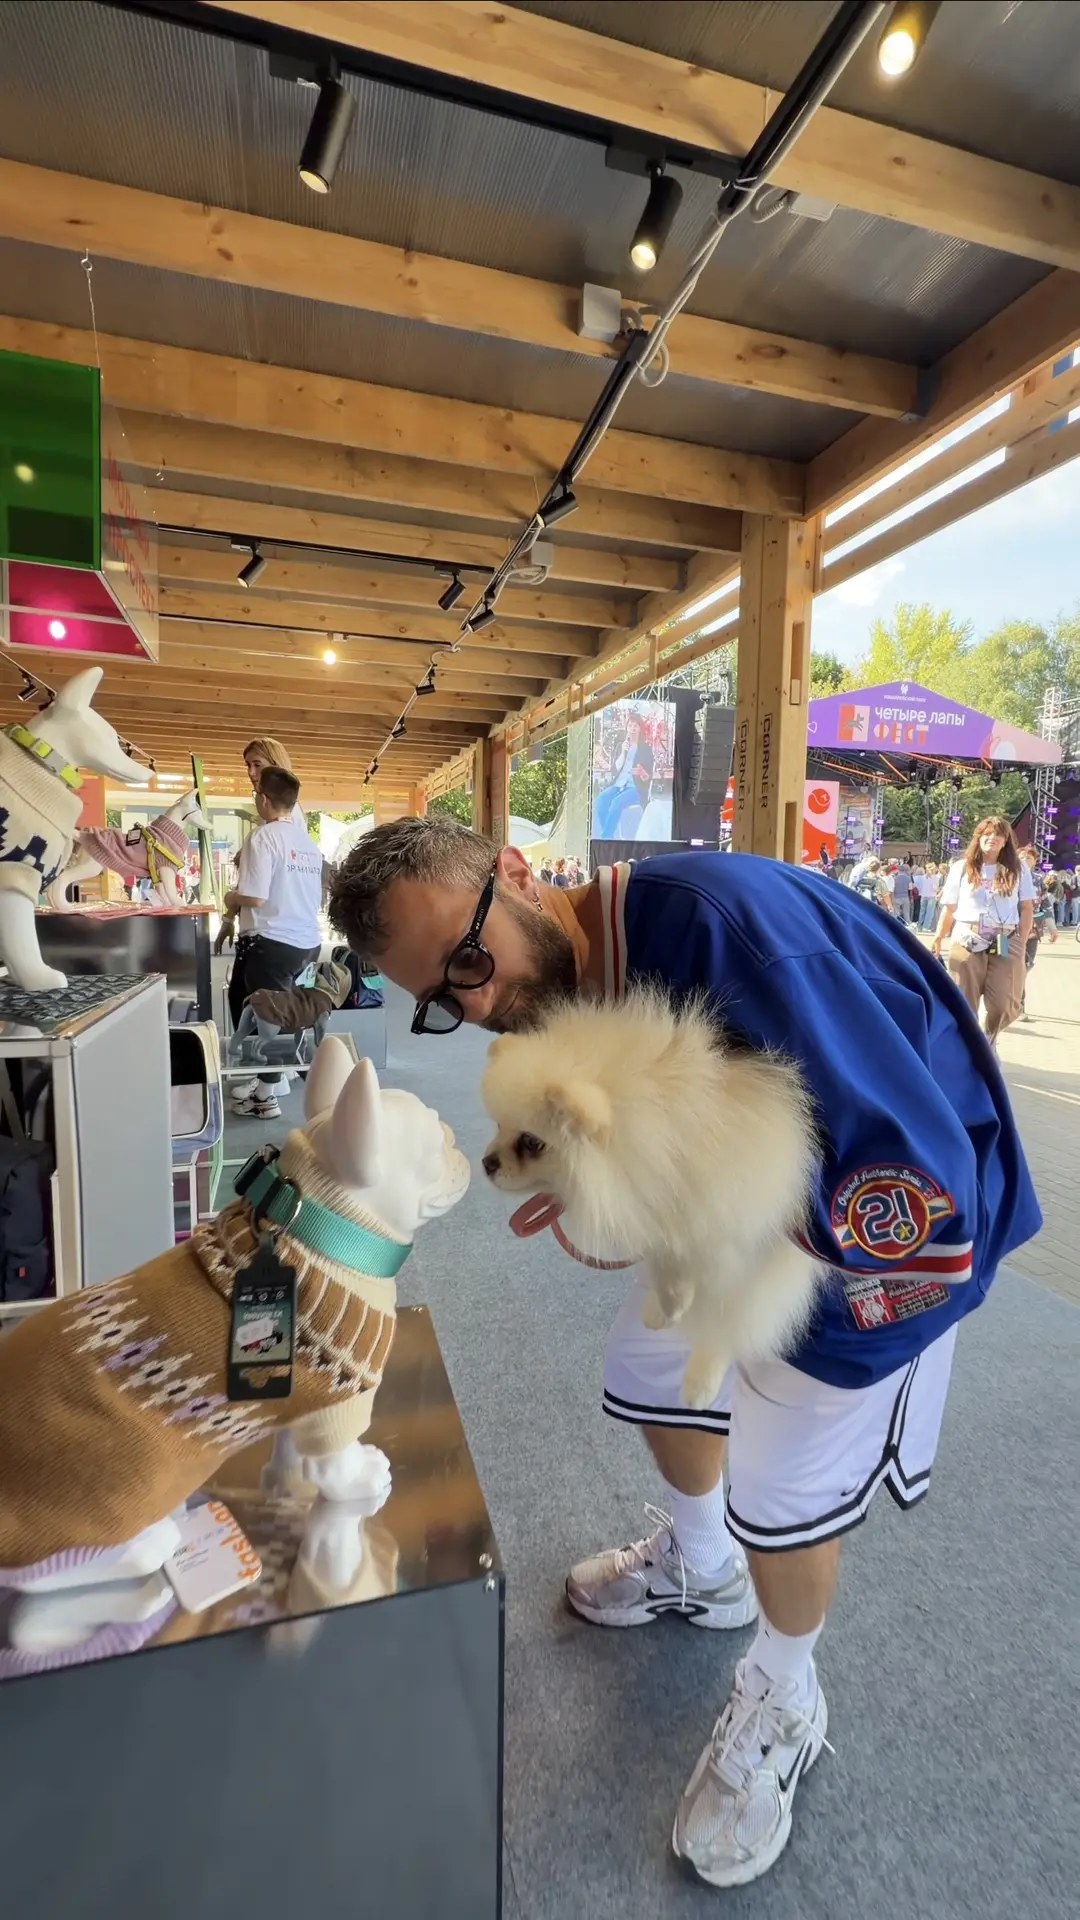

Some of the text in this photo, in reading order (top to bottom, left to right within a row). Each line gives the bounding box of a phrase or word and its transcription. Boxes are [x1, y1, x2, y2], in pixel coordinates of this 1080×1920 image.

[738, 722, 749, 811] CORNER
[760, 715, 772, 809] CORNER
[873, 721, 930, 747] ФЕСТ
